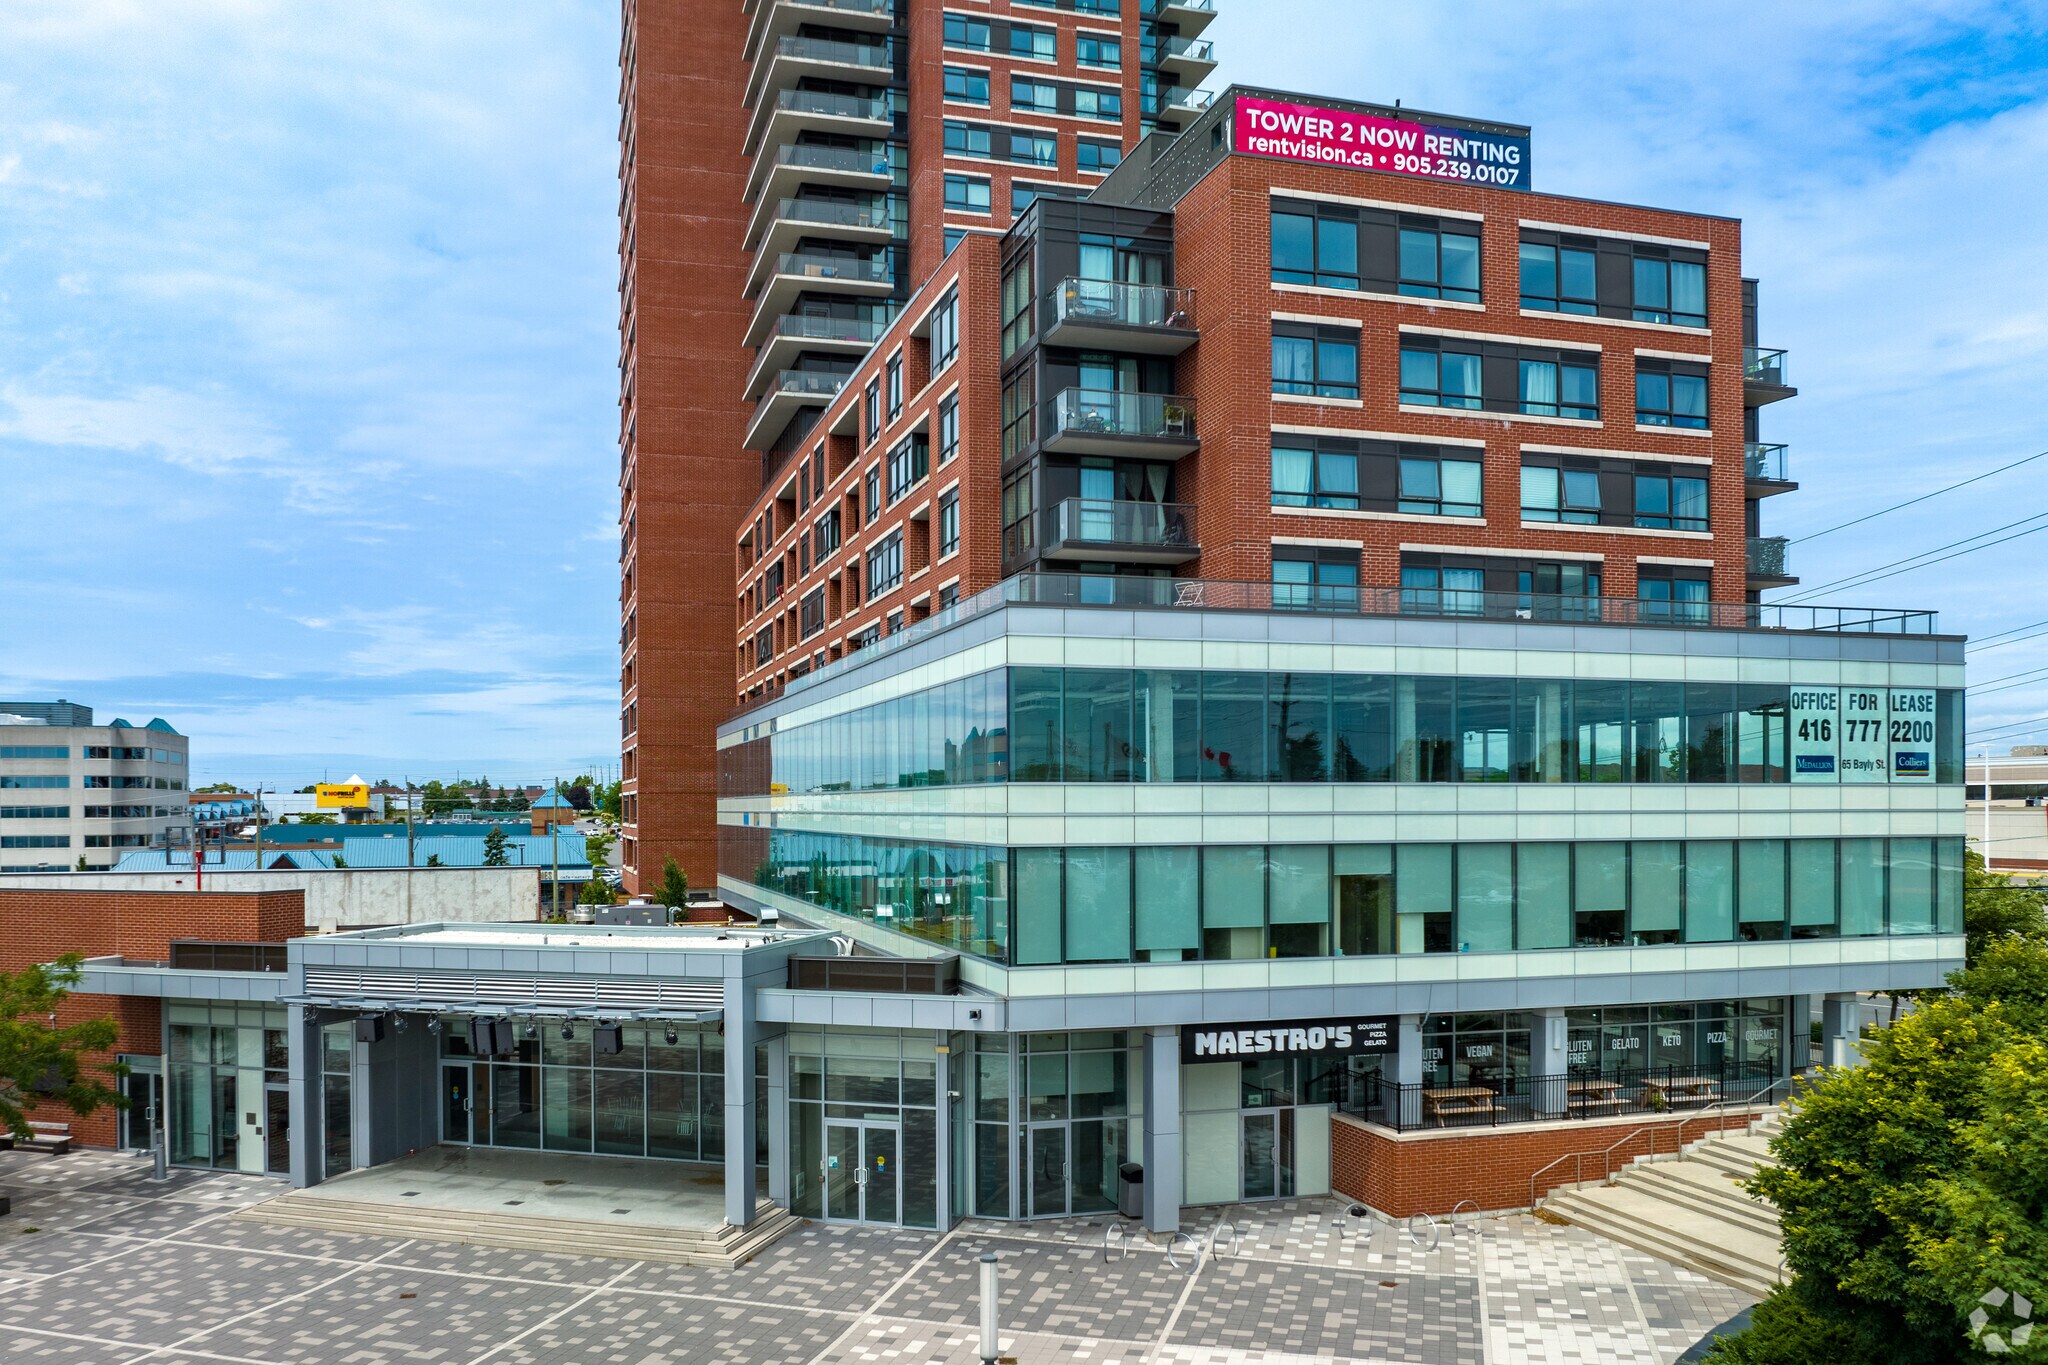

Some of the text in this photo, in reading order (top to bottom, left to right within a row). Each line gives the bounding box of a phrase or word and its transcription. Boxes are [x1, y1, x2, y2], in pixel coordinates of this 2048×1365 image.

[1246, 108, 1520, 164] TOWER 2 NOW RENTING
[1248, 136, 1519, 185] rentvision.ca 905.239.0107
[1792, 692, 1933, 712] OFFICE FOR LEASE
[1798, 719, 1933, 742] 416 777 2200
[1841, 759, 1886, 771] 65 Bayly St.
[1898, 757, 1926, 767] Colliers
[1195, 1026, 1352, 1055] MAESTRO'S
[1662, 1035, 1681, 1047] KETO
[1707, 1032, 1727, 1044] PIZZA
[1745, 1028, 1778, 1041] GOURMET
[1611, 1037, 1639, 1050] GELATO
[1422, 1047, 1443, 1060] UTEN
[1466, 1045, 1493, 1058] VEGAN
[1568, 1052, 1587, 1064] FREE
[1422, 1060, 1438, 1072] REE
